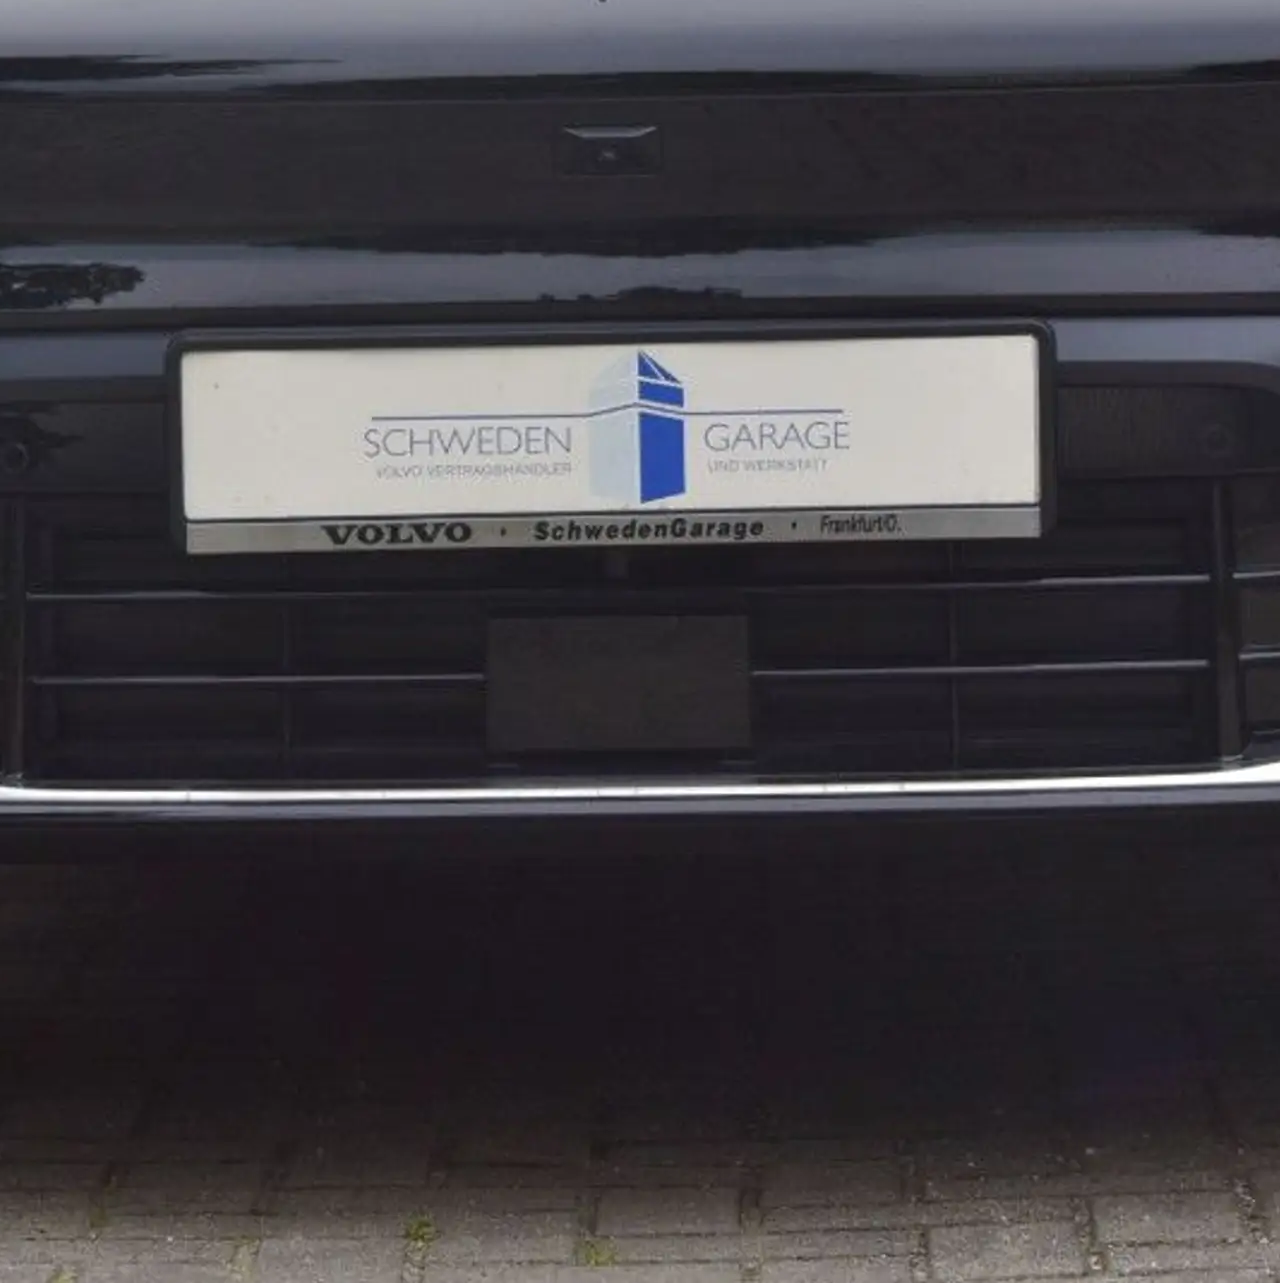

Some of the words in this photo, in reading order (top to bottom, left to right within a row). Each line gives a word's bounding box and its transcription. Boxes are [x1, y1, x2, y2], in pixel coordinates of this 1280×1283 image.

[363, 426, 573, 459] SCHWEDEN
[703, 420, 851, 452] GARAGE
[320, 522, 472, 546] VOLVO
[534, 518, 765, 541] SchwedenGarage
